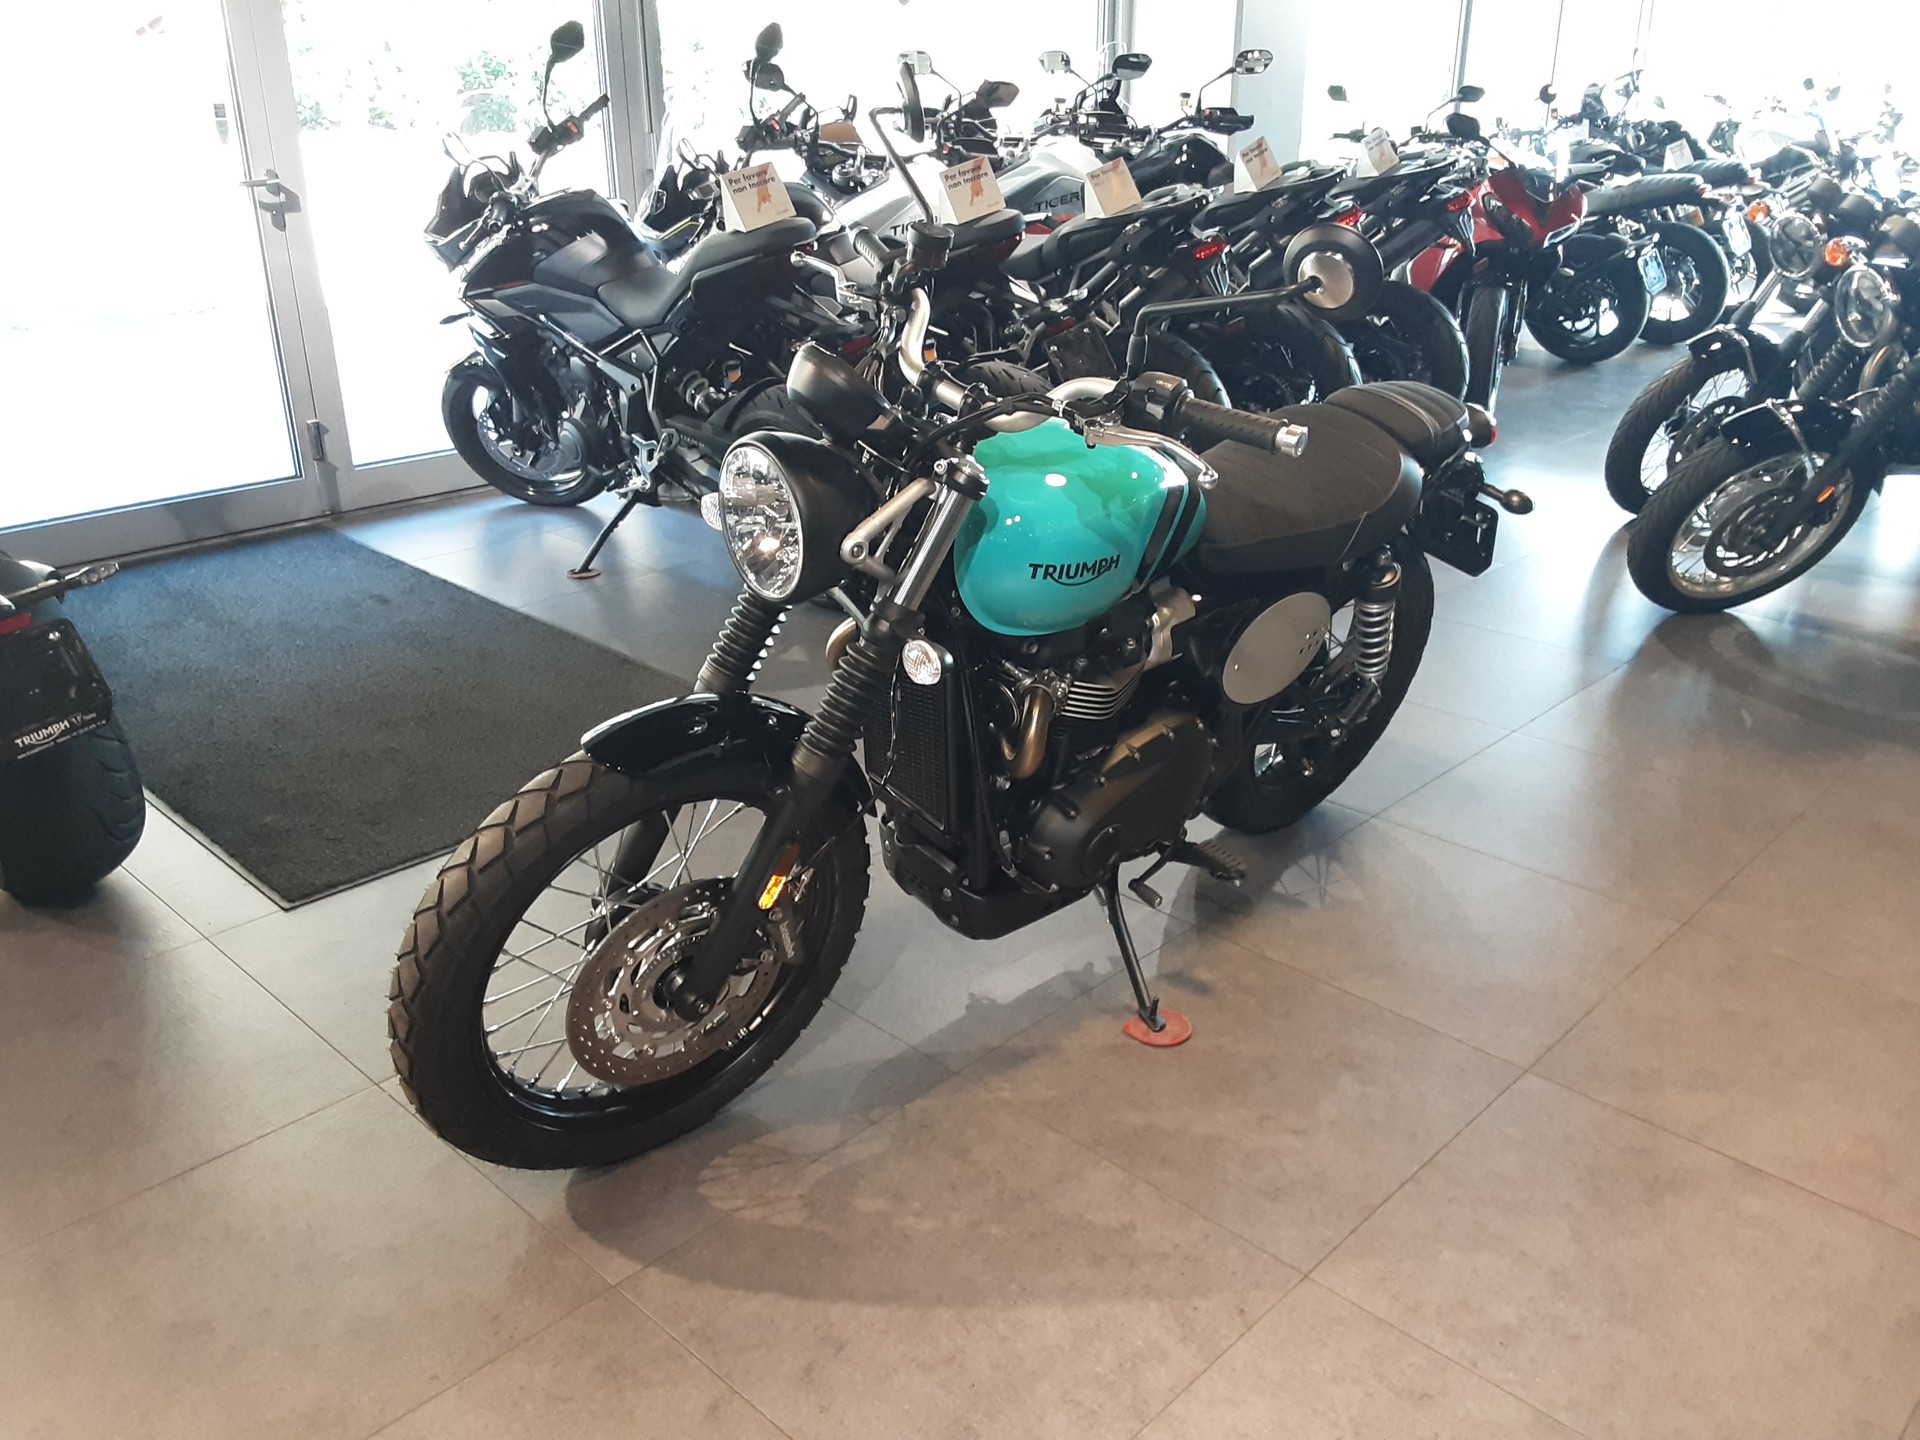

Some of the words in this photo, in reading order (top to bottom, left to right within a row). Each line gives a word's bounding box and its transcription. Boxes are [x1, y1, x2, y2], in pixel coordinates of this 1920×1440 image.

[728, 177, 741, 187] Per
[732, 185, 748, 195] non
[748, 176, 776, 189] toccare
[944, 173, 957, 182] Per
[948, 181, 962, 190] non
[1035, 191, 1080, 212] TIGER
[1028, 554, 1121, 586] TRIUMPH
[15, 719, 71, 748] TRIUMPH
